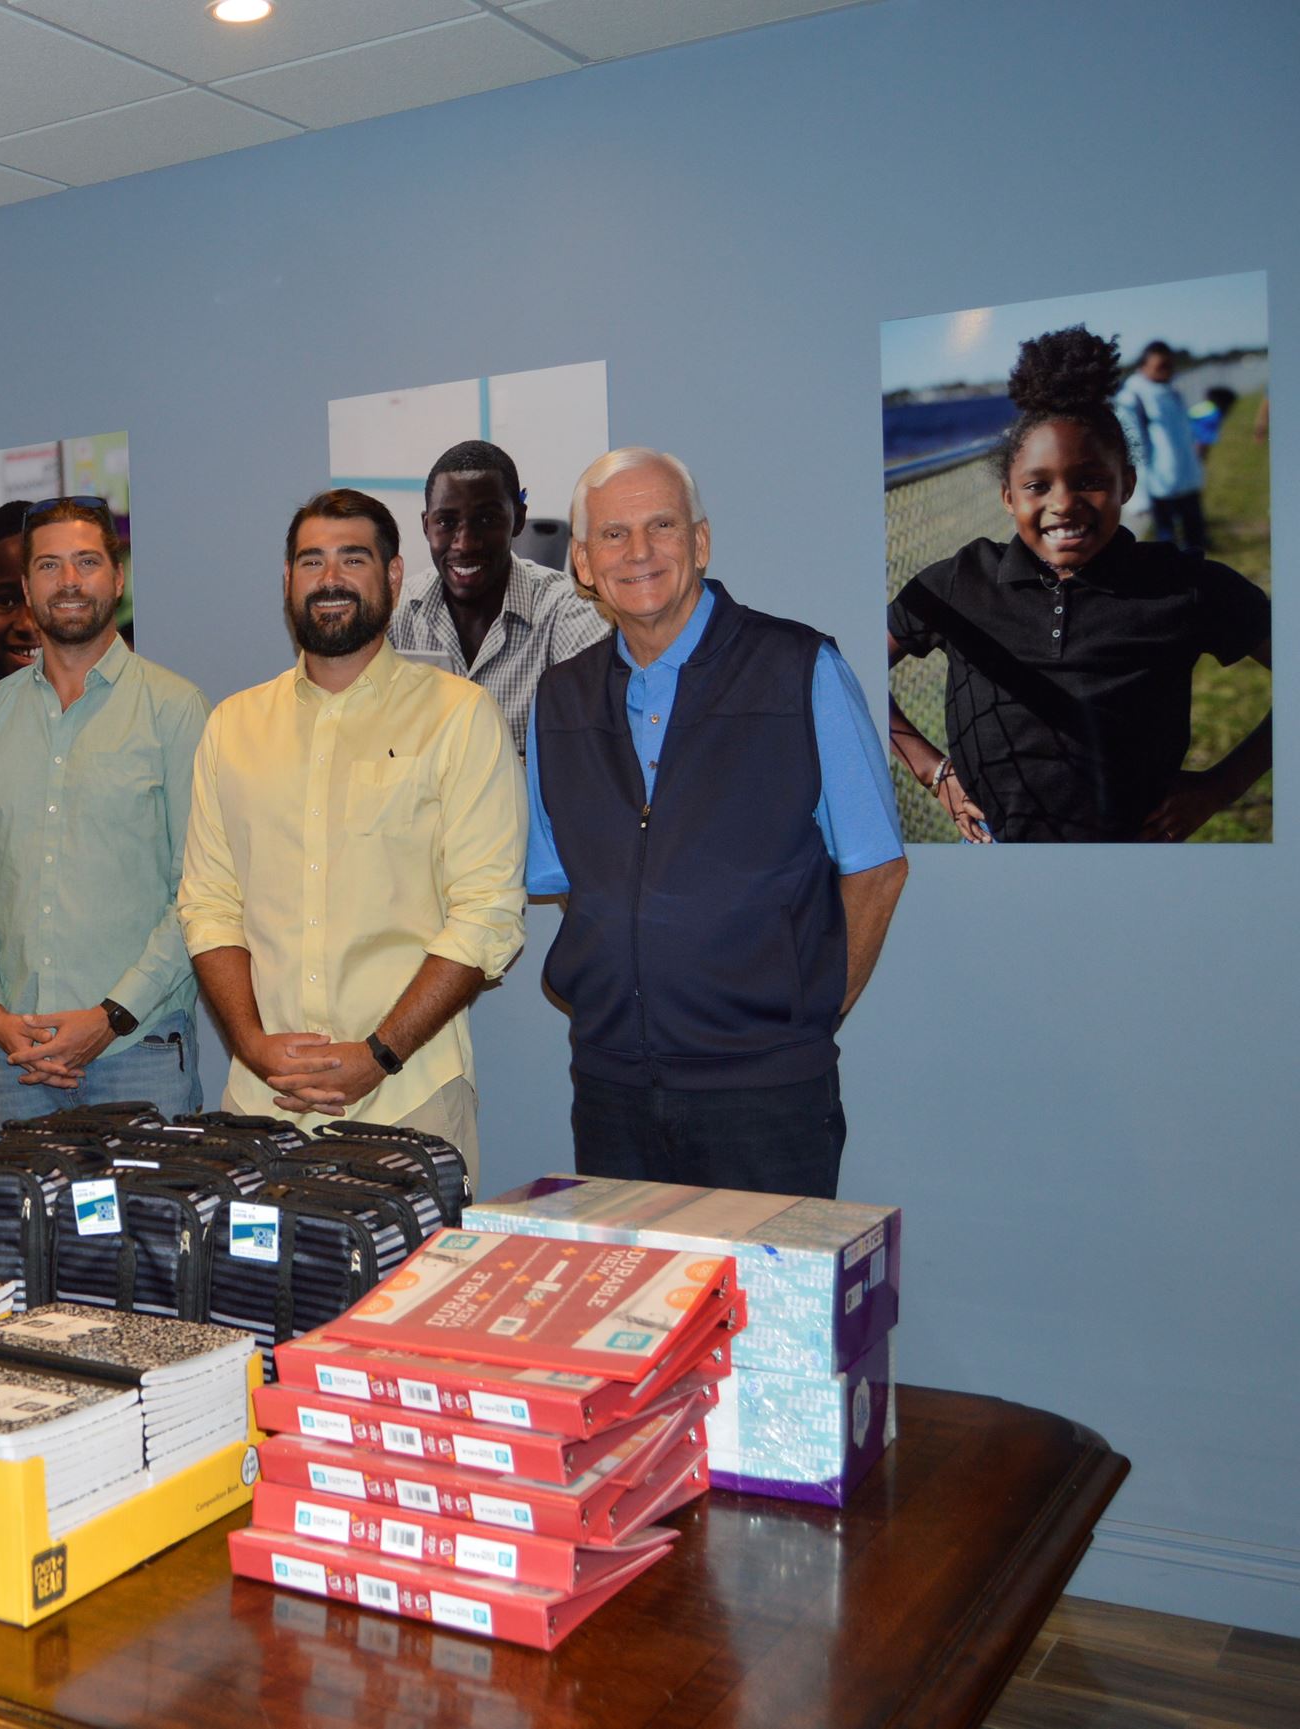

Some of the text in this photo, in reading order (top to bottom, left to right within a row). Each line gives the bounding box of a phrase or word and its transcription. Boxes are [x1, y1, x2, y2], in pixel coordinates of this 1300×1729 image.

[597, 1249, 626, 1276] VIEW
[586, 1250, 647, 1308] DURABLE
[425, 1270, 493, 1327] DURABLE
[445, 1302, 479, 1328] VIEW
[34, 1555, 64, 1586] pen+
[38, 1569, 63, 1599] GEAR
